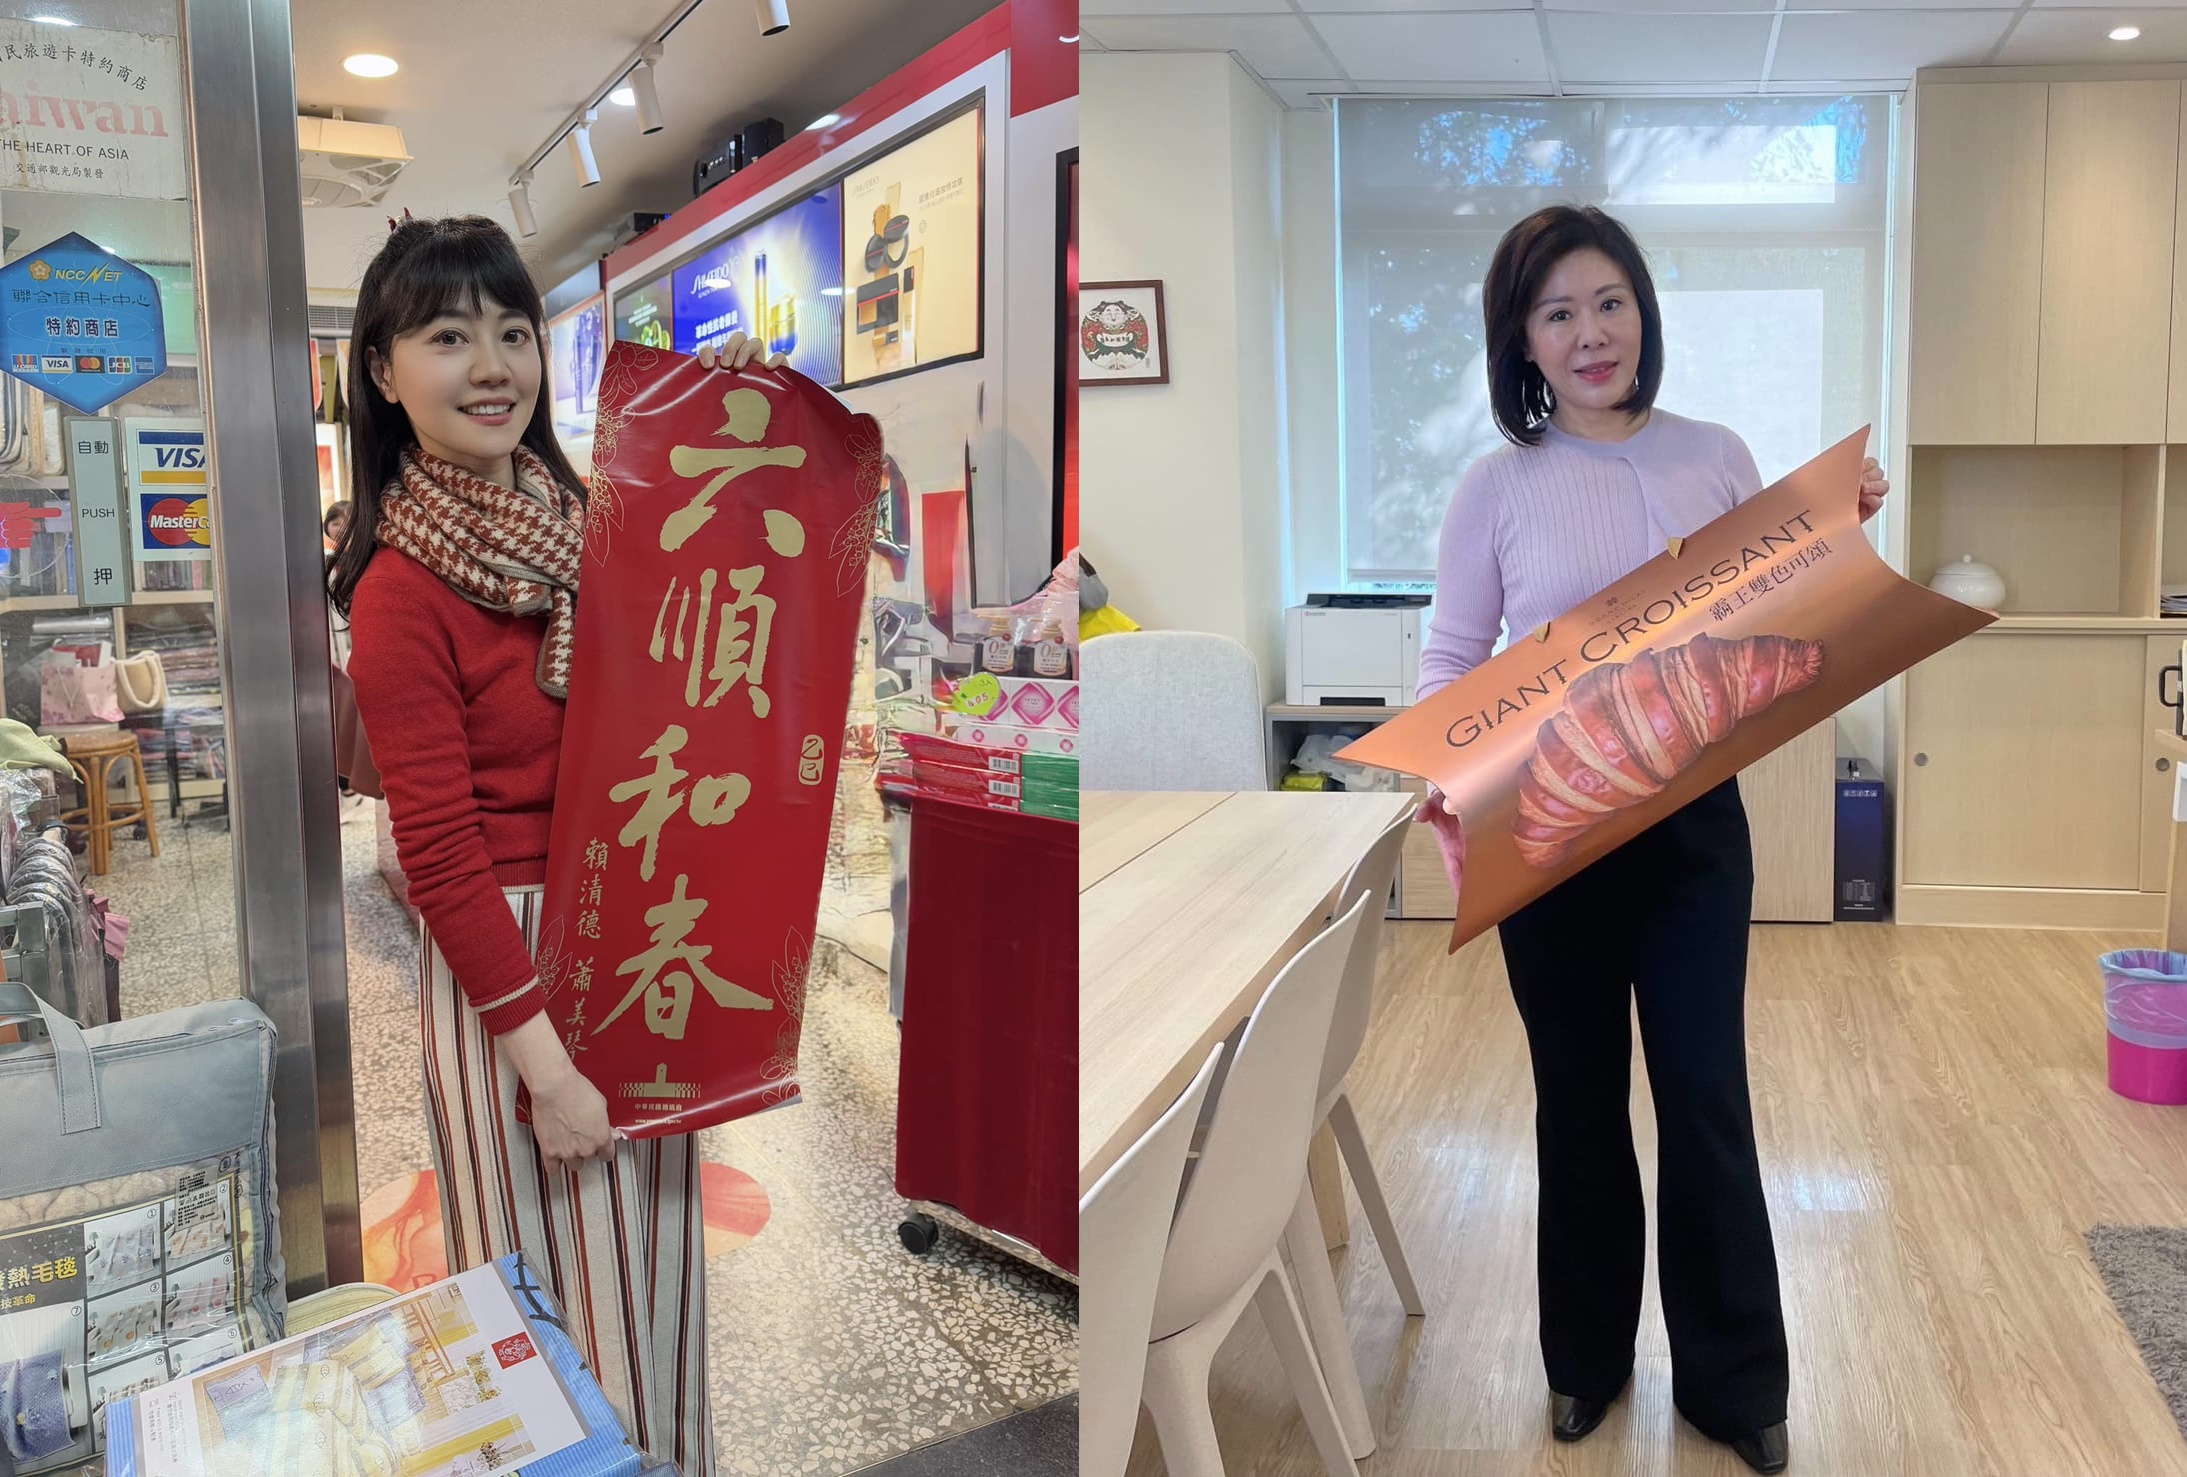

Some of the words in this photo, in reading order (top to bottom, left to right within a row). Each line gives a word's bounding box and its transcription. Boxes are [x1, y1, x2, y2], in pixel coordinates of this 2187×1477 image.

[0, 43, 148, 91] 民旅遊卡特約商店
[26, 141, 71, 155] HEART
[76, 145, 93, 157] OF
[98, 147, 129, 160] ASIA
[16, 162, 104, 179] 交通部觀光局製發
[11, 289, 150, 308] 聯合信用卡中心
[46, 317, 119, 338] 特約商店
[46, 360, 69, 368] VISA
[109, 361, 130, 369] JCB
[78, 441, 108, 455] 自動
[154, 447, 206, 468] VIS
[82, 508, 115, 518] PUSH
[93, 567, 113, 585] 押
[1708, 537, 1832, 623] 霸王雙色可頌
[1446, 659, 1568, 748] GIANT
[1579, 509, 1815, 663] CROISSANT
[591, 388, 806, 1040] 六順和春
[574, 837, 609, 940] 賴清德
[565, 956, 595, 1061] 蕭美琴
